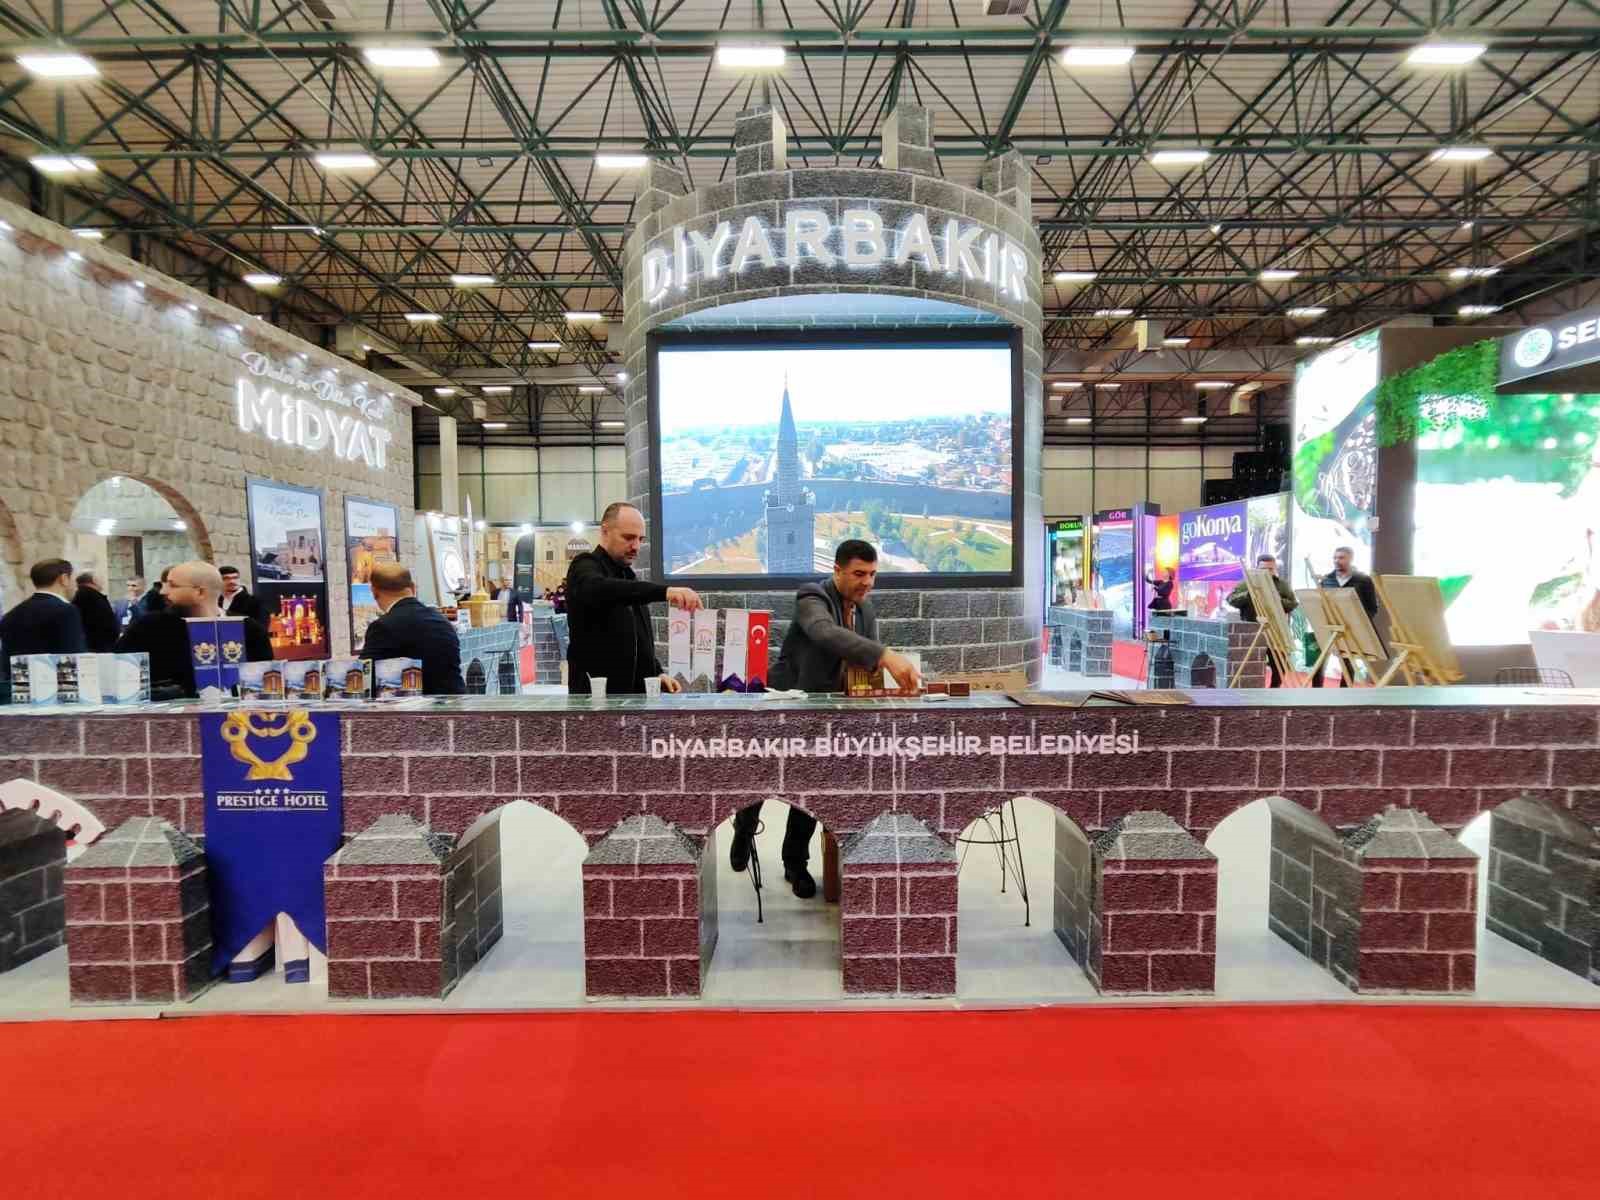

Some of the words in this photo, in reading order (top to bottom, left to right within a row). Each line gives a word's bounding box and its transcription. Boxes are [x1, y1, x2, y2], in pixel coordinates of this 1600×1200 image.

[642, 208, 1029, 302] DİYARBAKIR
[1557, 318, 1600, 349] SE
[237, 377, 392, 470] MİDYAT
[1182, 514, 1242, 544] goKonya
[651, 733, 807, 758] DİYARBAKIR
[815, 731, 981, 761] BÜYÜKŞEHİR
[990, 729, 1139, 755] BELEDİYESİ
[216, 795, 279, 807] PRESTIGE
[284, 794, 328, 806] HOTEL
